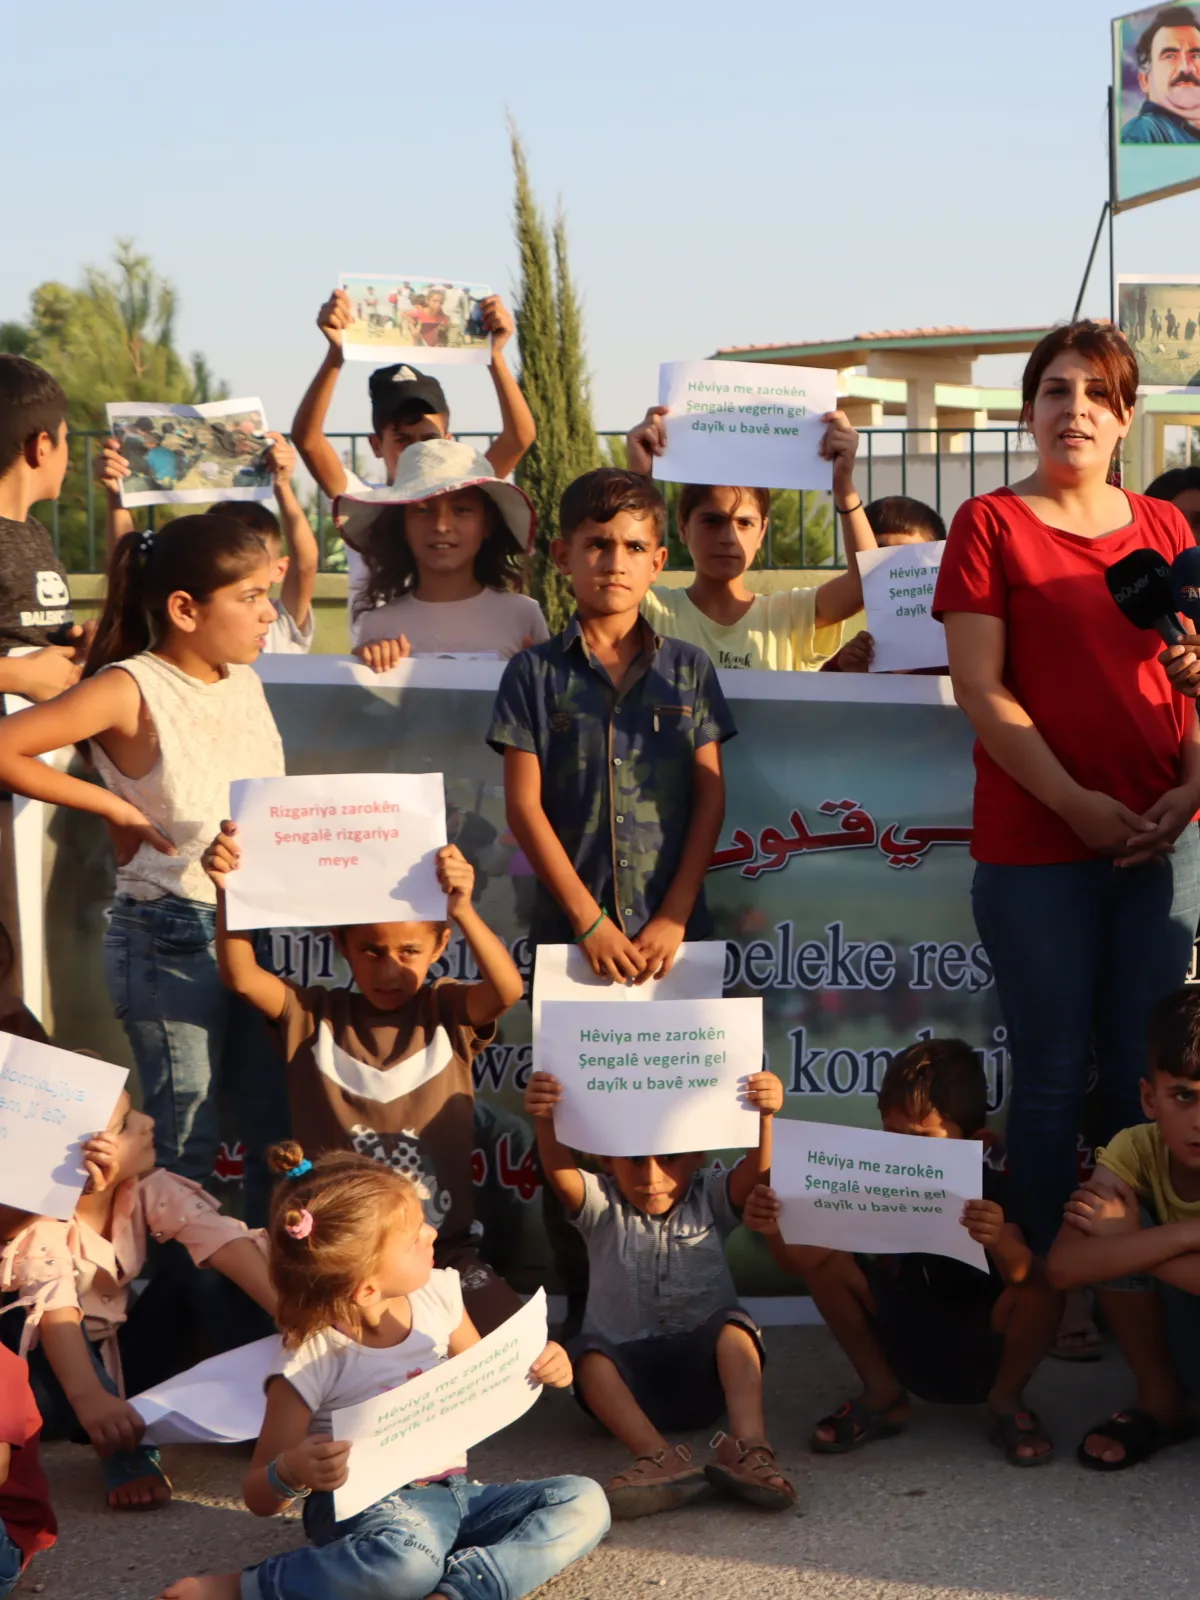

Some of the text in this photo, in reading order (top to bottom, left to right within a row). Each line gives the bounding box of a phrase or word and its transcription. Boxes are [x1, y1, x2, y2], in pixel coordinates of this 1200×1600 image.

[688, 381, 805, 397] Hêviya me zarokên
[686, 400, 806, 418] Şengalê vegerin gel
[692, 420, 725, 435] dayîk
[741, 422, 770, 434] bavê
[774, 427, 799, 436] xwe
[889, 566, 927, 579] Hêviya
[889, 584, 933, 600] Şengalê
[896, 604, 927, 617] dayîk
[269, 801, 400, 820] Rizgariya zarokên
[274, 827, 399, 845] Şengalê rizgariya
[318, 855, 359, 868] meye
[580, 1027, 726, 1045] Hêviya me zarokên
[579, 1051, 727, 1069] Şengalê vegerin gel
[586, 1075, 719, 1093] dayîk u bavê xwe
[807, 1150, 944, 1179] Hêviya me zarokên
[805, 1175, 946, 1200] Şengalê vegerin gel
[814, 1199, 854, 1212] dayîk
[872, 1201, 908, 1212] bavê
[912, 1206, 943, 1214] xwe
